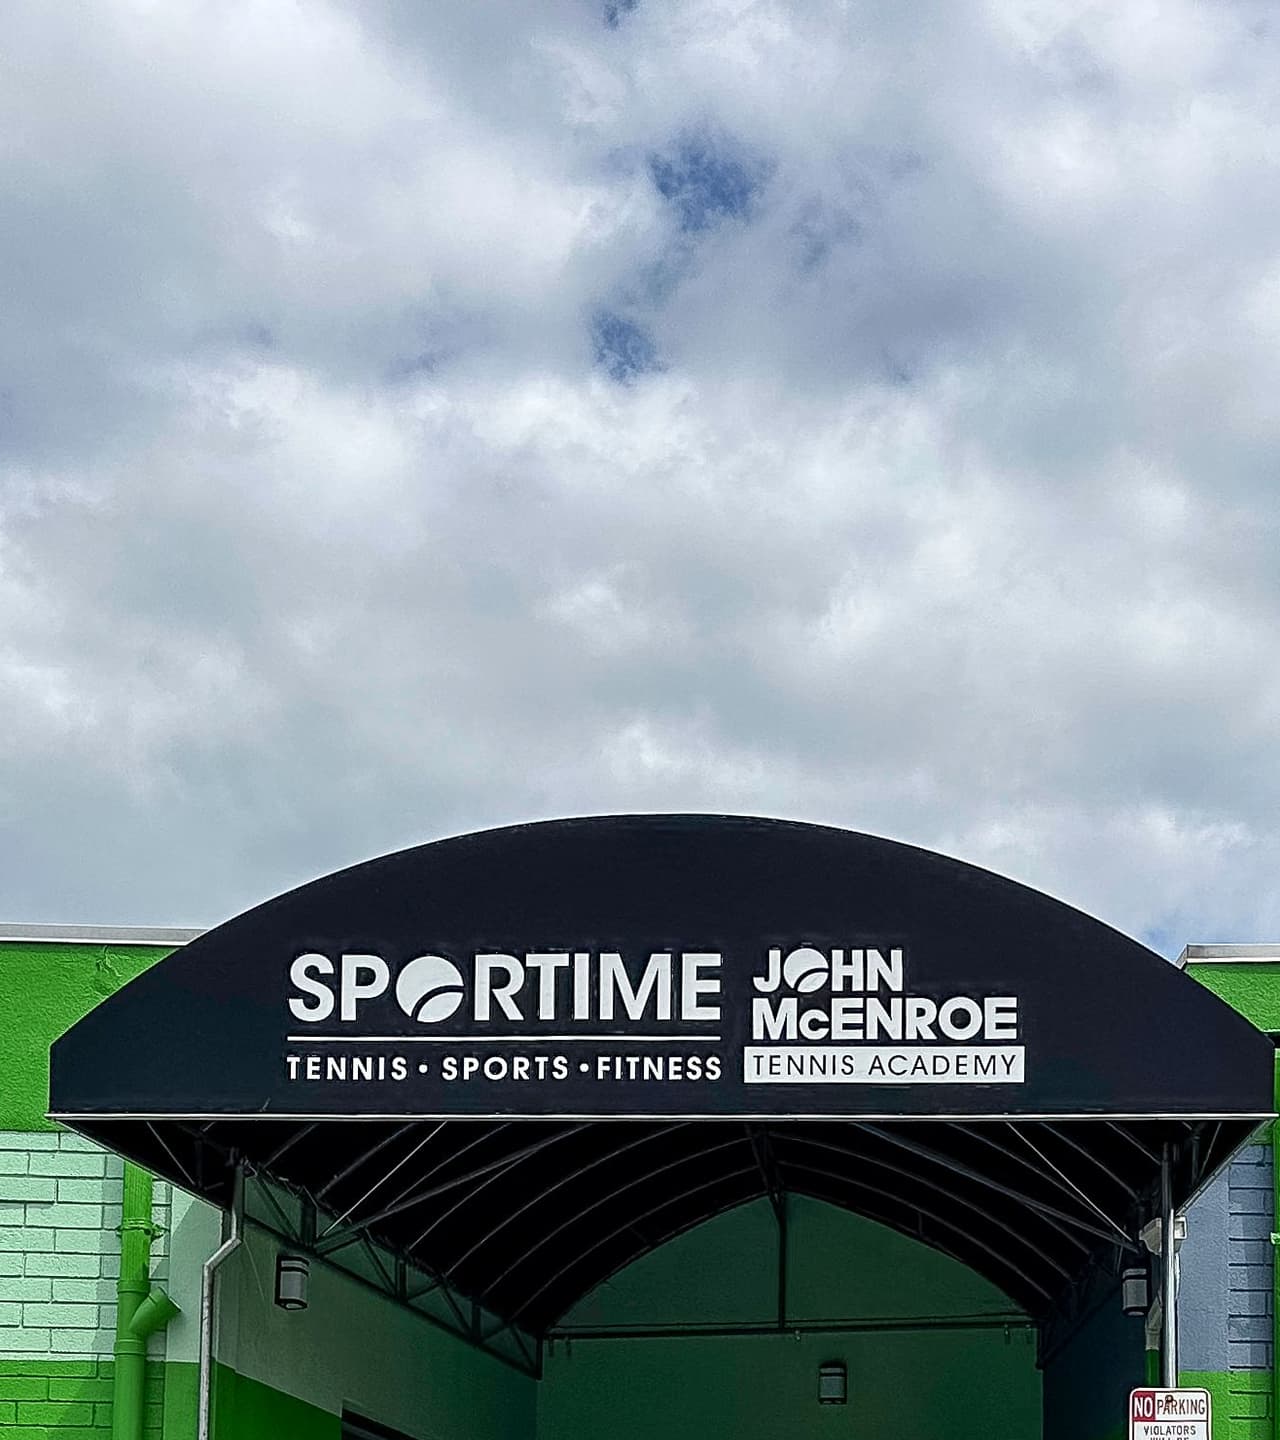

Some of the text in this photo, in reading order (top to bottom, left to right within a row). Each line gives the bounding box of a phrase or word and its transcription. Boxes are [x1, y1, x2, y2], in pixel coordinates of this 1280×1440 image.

[752, 947, 904, 993] JOHN
[288, 953, 721, 1023] SPORTIME
[286, 1056, 722, 1081] TENNIS SPORTS FITNESS
[752, 1054, 1017, 1076] TENNIS ACADEMY
[1133, 1396, 1206, 1418] NO PARKING
[1143, 1425, 1197, 1436] VIOLATORS
